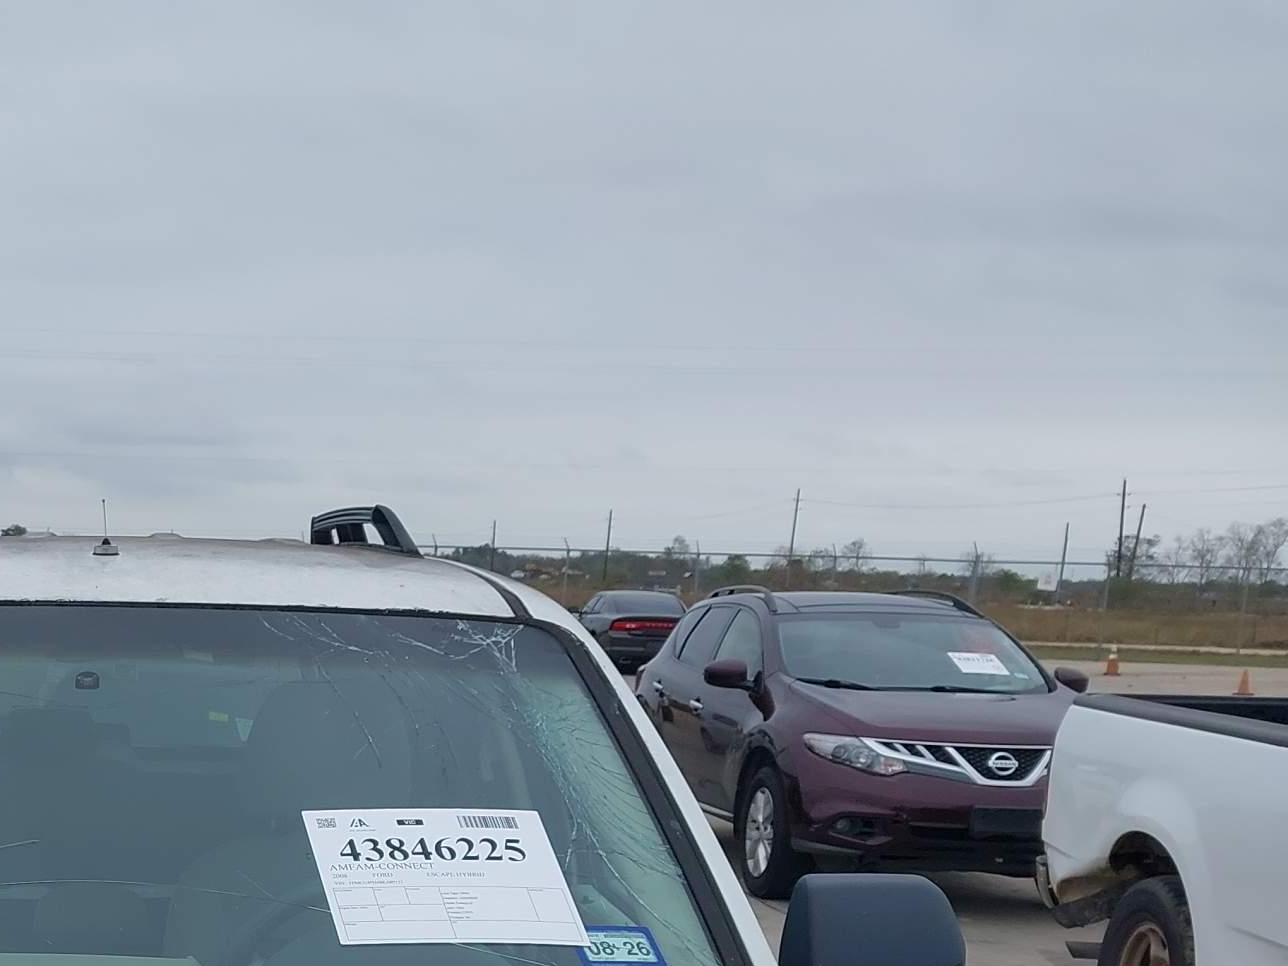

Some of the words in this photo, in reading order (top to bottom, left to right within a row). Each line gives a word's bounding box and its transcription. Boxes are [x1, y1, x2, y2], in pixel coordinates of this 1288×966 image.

[339, 837, 527, 862] 43846225
[329, 861, 435, 872] AMFAM-CONNECT
[622, 941, 651, 956] 26
